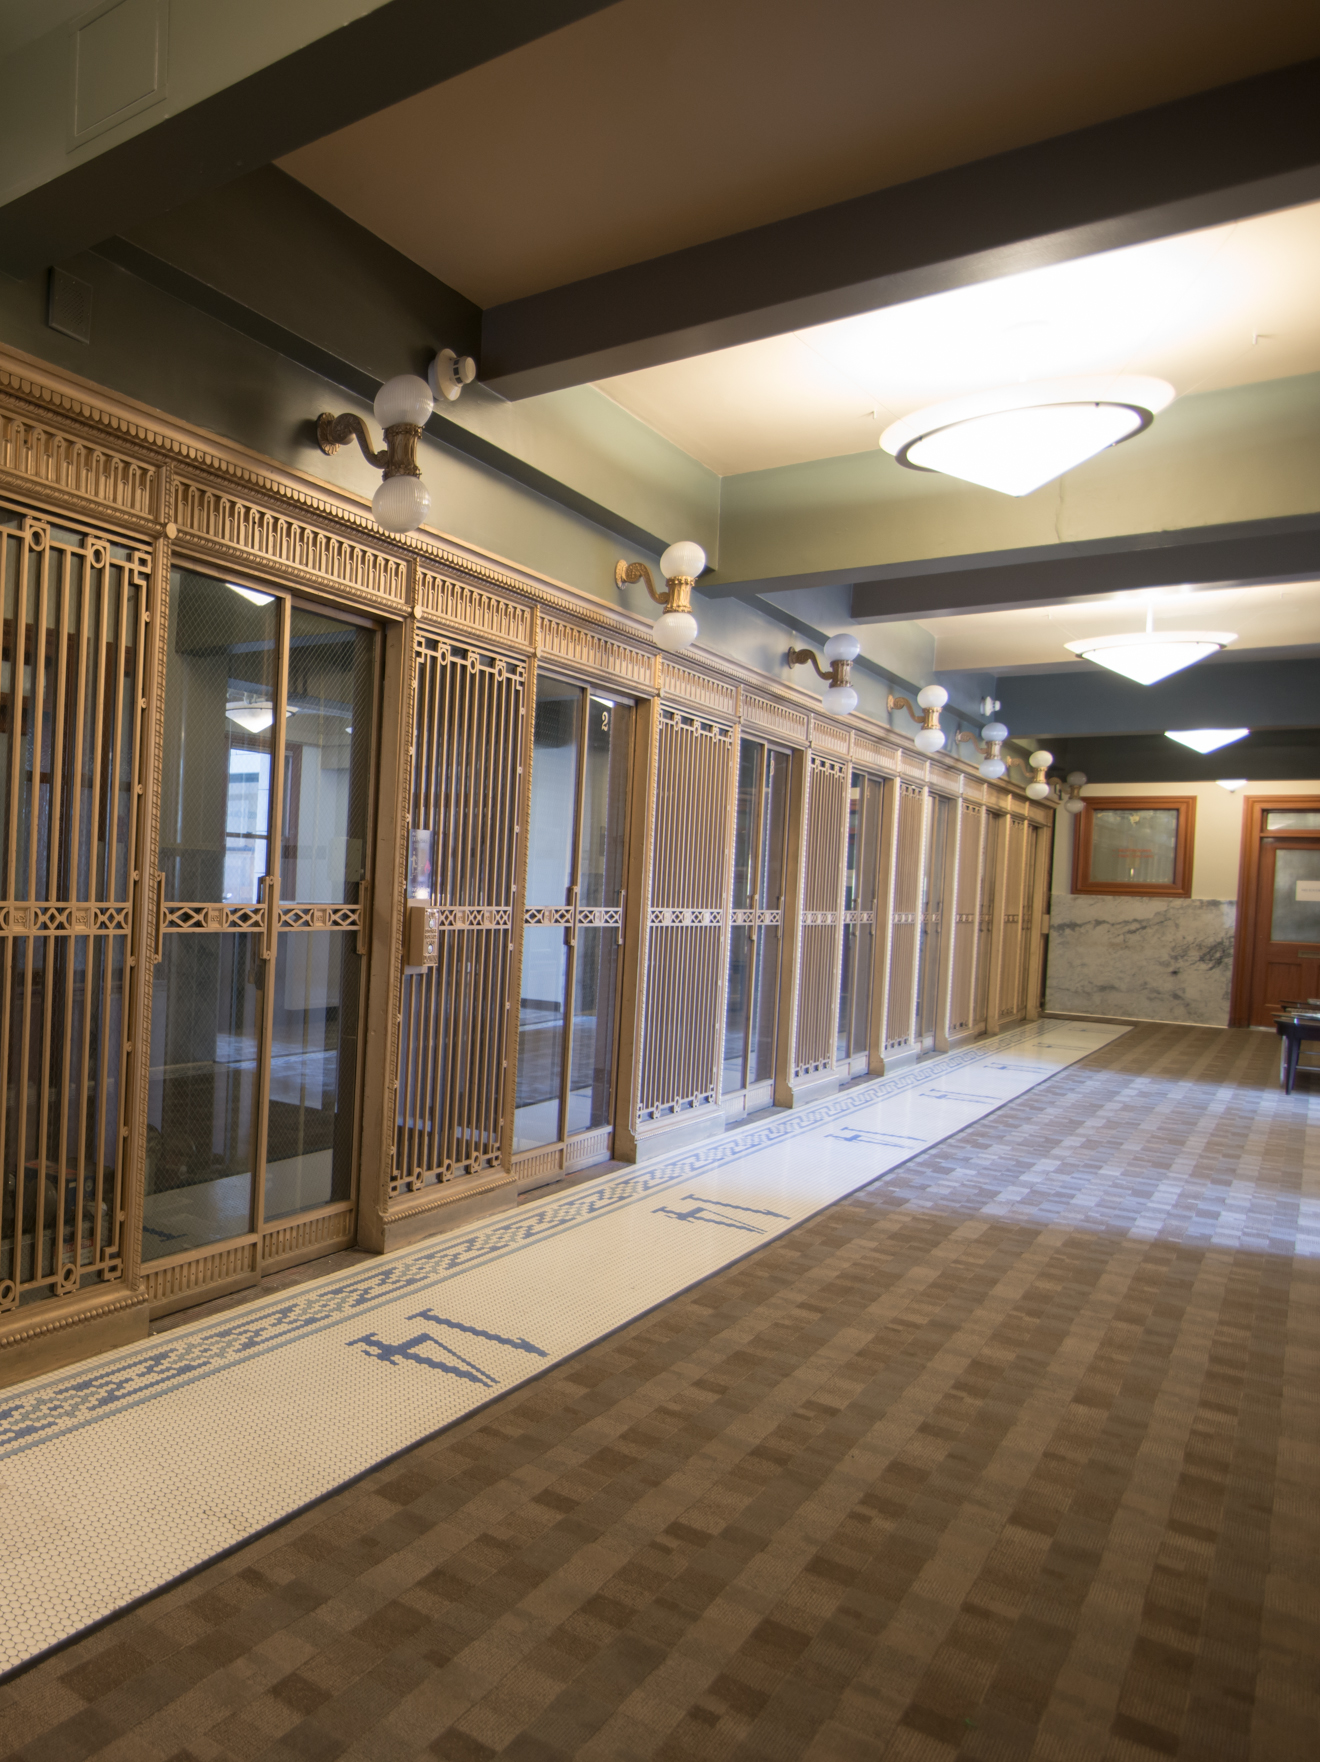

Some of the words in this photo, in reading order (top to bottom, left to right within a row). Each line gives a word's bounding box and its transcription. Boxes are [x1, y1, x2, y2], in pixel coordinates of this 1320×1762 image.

[601, 711, 609, 732] 2
[650, 1194, 791, 1235] 14
[345, 1308, 550, 1388] 14
